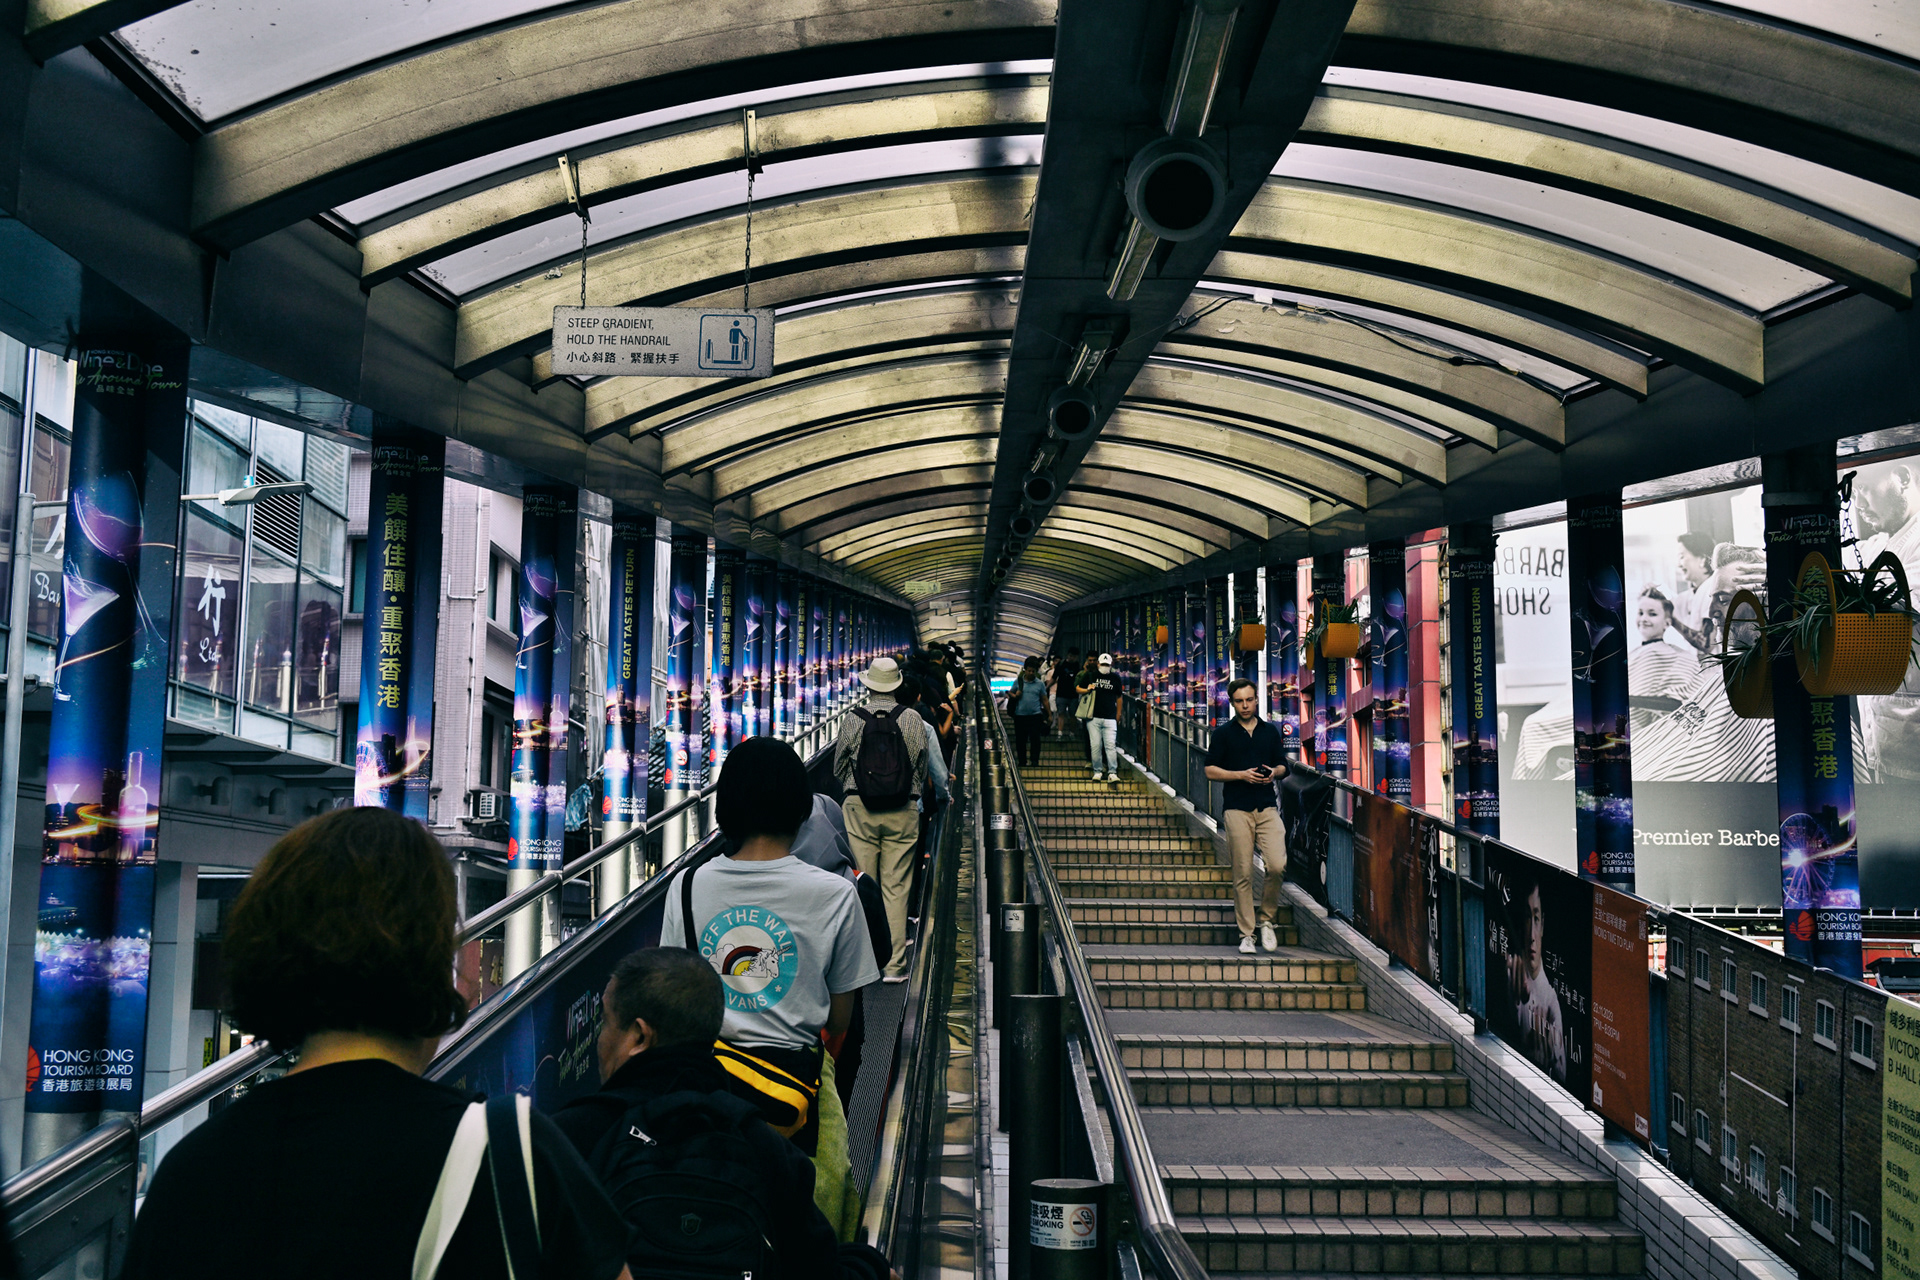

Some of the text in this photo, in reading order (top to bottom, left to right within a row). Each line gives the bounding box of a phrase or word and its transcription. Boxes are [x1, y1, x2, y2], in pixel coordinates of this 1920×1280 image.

[568, 318, 654, 330] STEEP GRADIENT,
[567, 334, 671, 346] HOLD THE HANDRAIL
[197, 564, 226, 636] 行
[622, 548, 635, 680] GREAT TASTES RETURN
[1471, 587, 1484, 719] GREAT TASTES RETURN
[1633, 829, 1780, 847] Premier Barbe
[1816, 912, 1847, 922] HONG
[1817, 922, 1850, 930] TOURISM
[701, 909, 794, 962] OFF THE WALL
[1594, 925, 1607, 940] WONG
[1623, 939, 1634, 952] PLAY
[728, 993, 768, 1009] VANS
[43, 1048, 134, 1063] HONG KONG
[43, 1063, 133, 1076] TOURISM BOARD
[1888, 1057, 1917, 1084] B HALL
[42, 1077, 133, 1092] 香港旅遊發展局
[1887, 1114, 1900, 1129] NEW
[1887, 1129, 1913, 1152] HERITAGE
[1733, 1155, 1775, 1210] B HALL
[1886, 1177, 1918, 1204] OPEN DAILY
[1886, 1253, 1900, 1270] FREE
